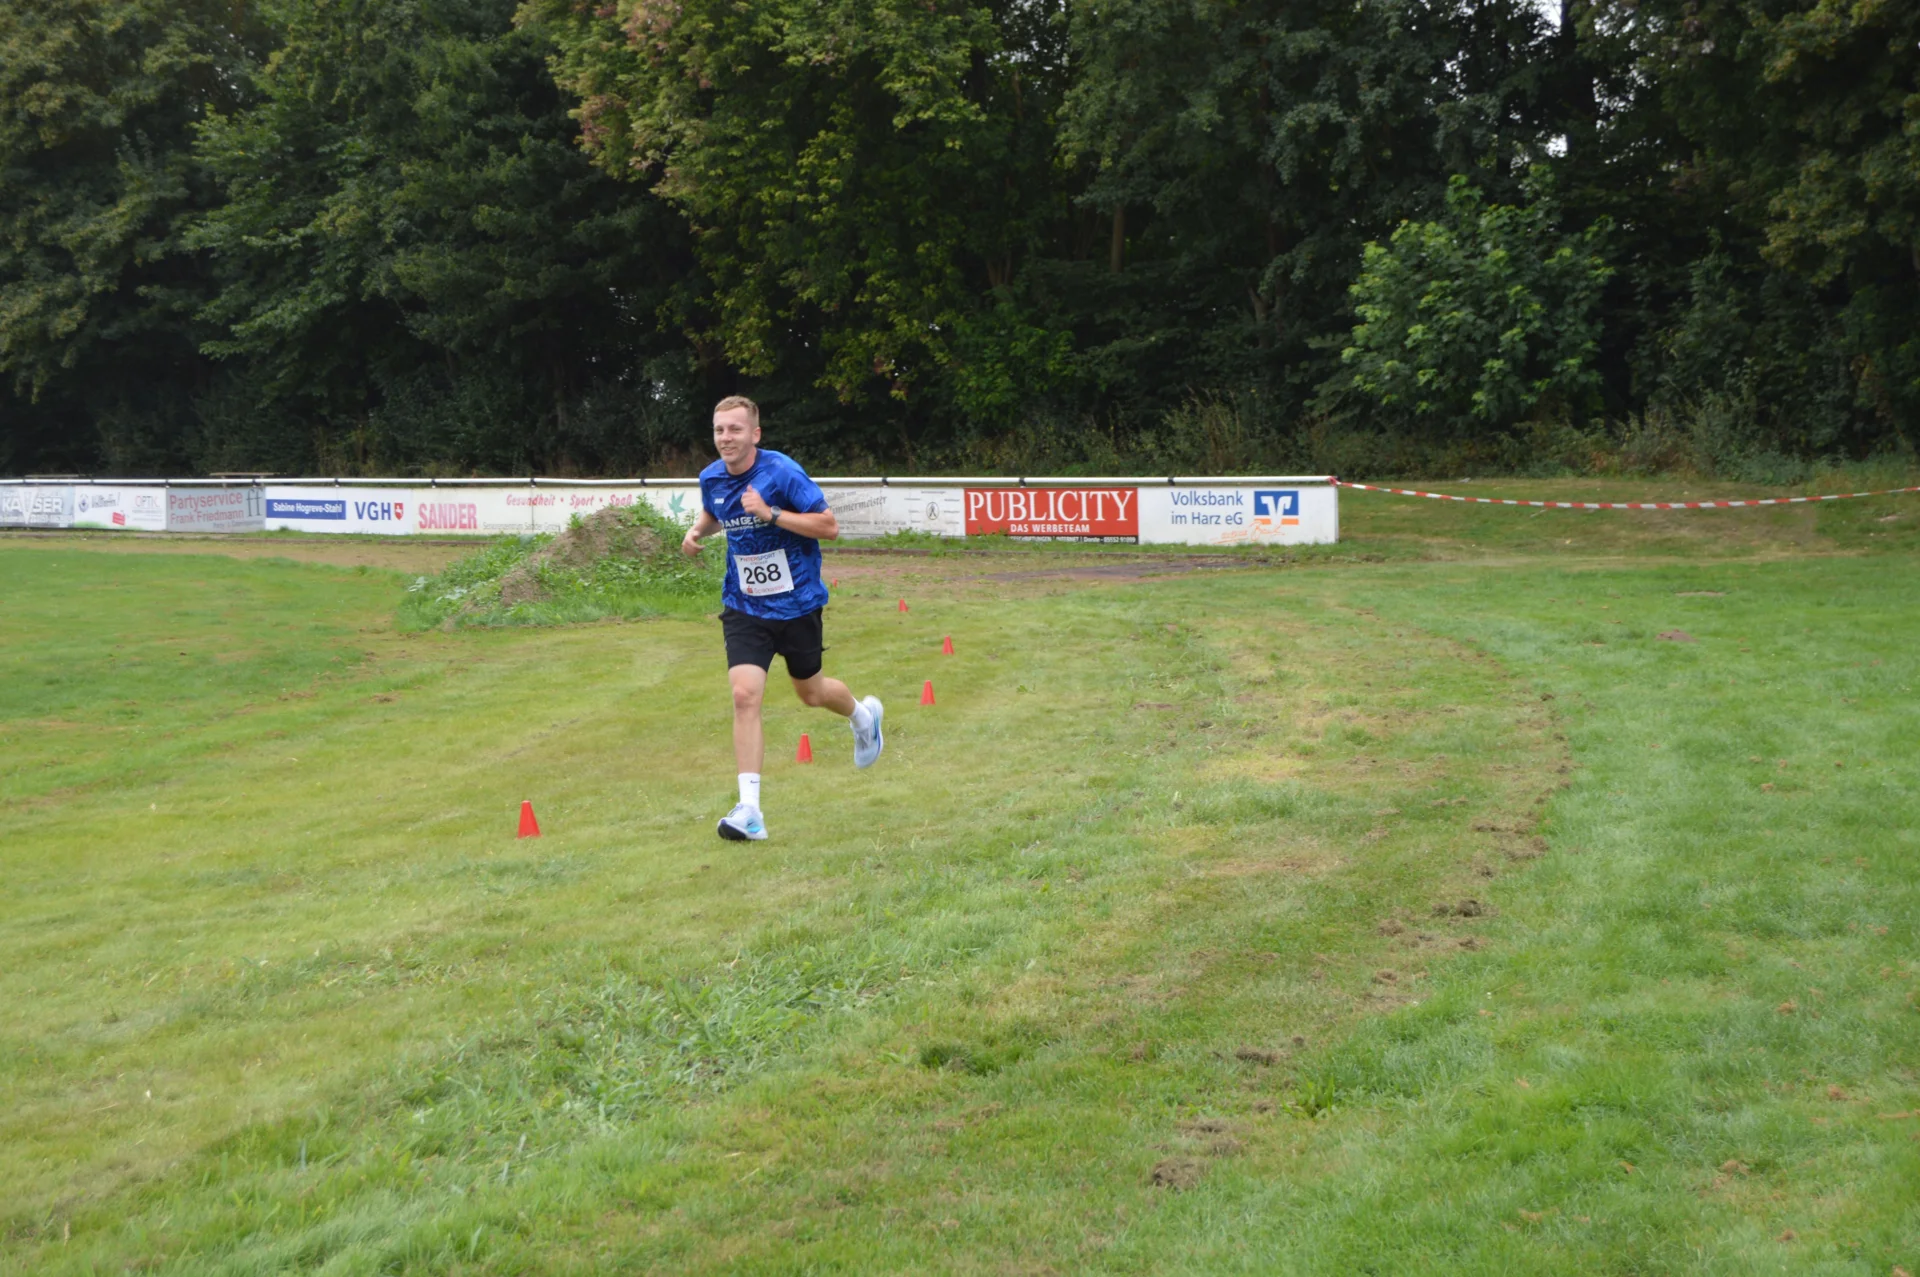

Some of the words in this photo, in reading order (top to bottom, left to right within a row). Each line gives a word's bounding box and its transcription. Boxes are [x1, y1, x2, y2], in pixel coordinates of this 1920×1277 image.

[169, 491, 243, 512] Partyservice
[506, 494, 555, 506] Gesundheit
[569, 494, 595, 509] Sport
[829, 495, 887, 515] immermeister
[967, 490, 1134, 522] PUBLICITY
[1171, 490, 1244, 506] Volksbank
[273, 502, 295, 512] Sabine
[296, 503, 342, 514] Hogreve-Stahl
[354, 501, 391, 520] VGH
[418, 503, 477, 529] SANDER
[170, 513, 195, 524] Frank
[196, 510, 244, 523] Friedmann
[1171, 512, 1188, 525] im
[1191, 512, 1221, 525] Harz
[1225, 512, 1243, 525] eG
[1010, 523, 1029, 533] DAS
[1032, 523, 1090, 533] WERBETEAM
[743, 563, 782, 585] 268
